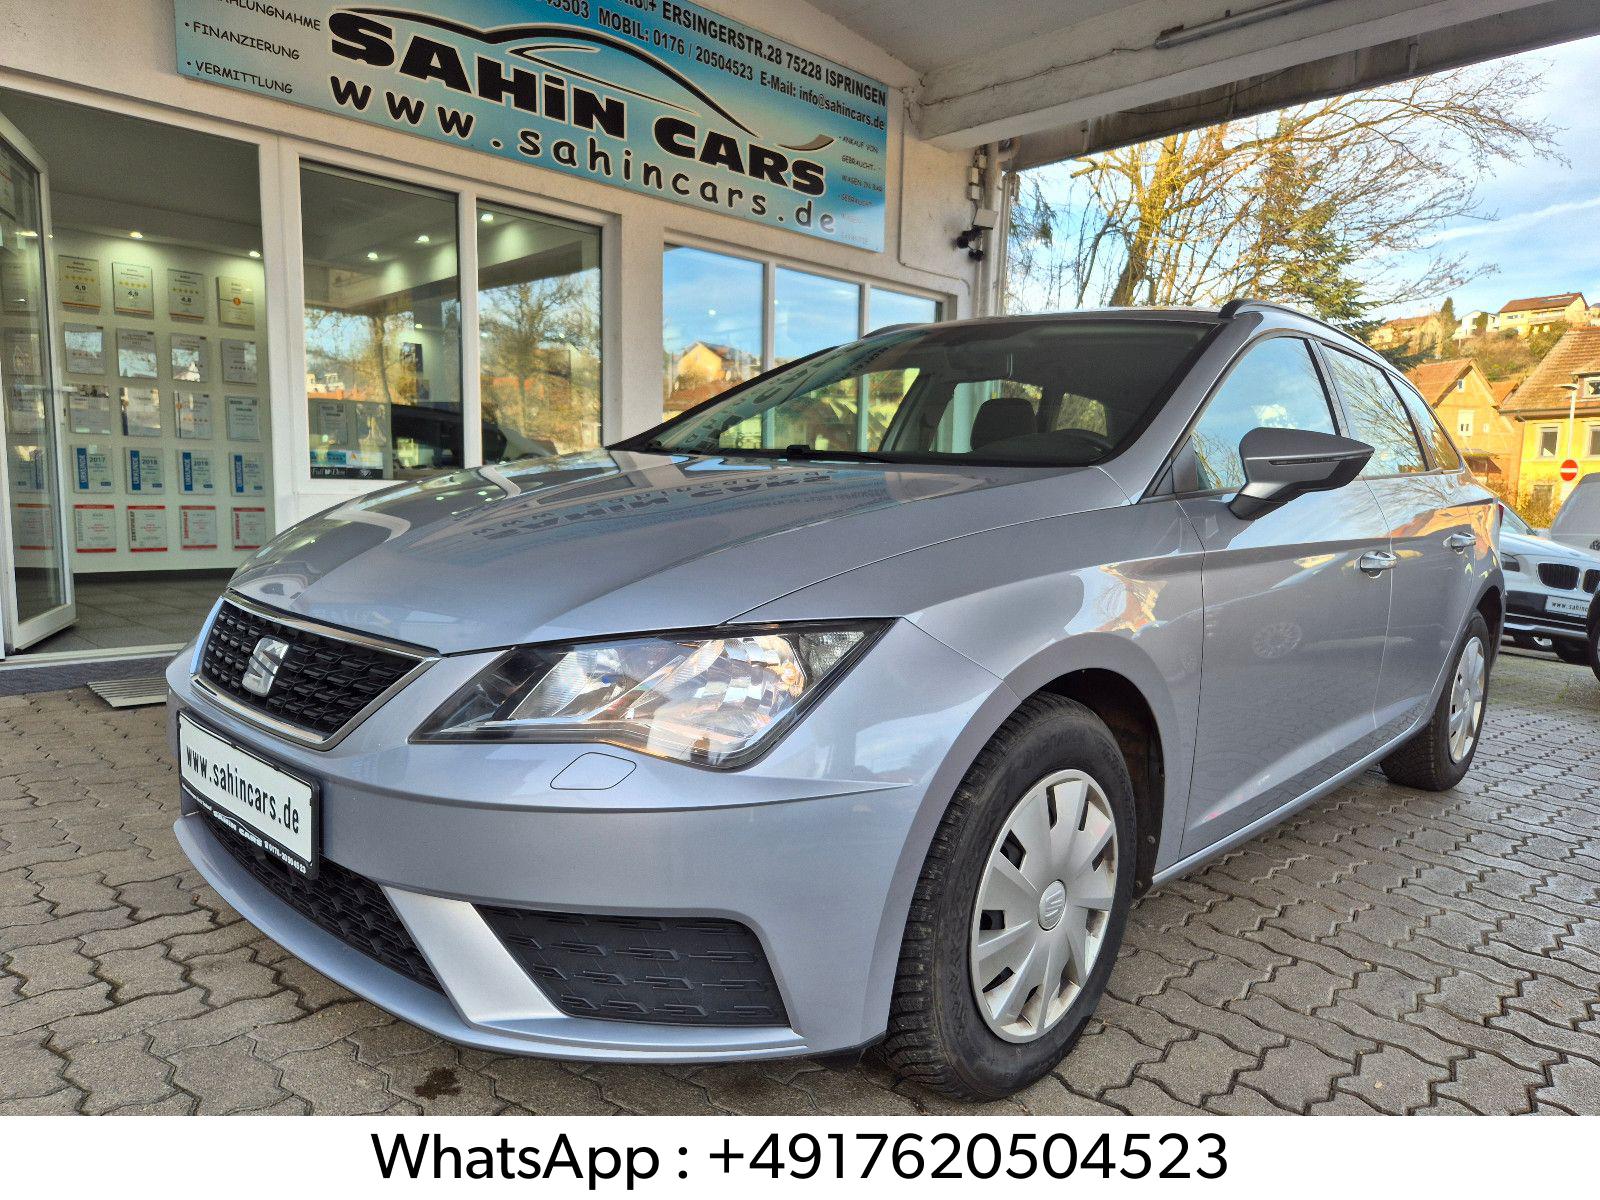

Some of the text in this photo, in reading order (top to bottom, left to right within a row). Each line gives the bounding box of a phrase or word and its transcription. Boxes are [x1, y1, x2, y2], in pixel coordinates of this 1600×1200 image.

[193, 21, 300, 60] FINANZIERUNG
[217, 0, 321, 31] HLUNGNAHME
[662, 1, 886, 107] ERSINGERSTR.28 75228 ISPRINGEN
[195, 59, 293, 94] VERMITTLUNG
[599, 7, 648, 42] MOBIL:
[653, 29, 685, 55] 0176
[695, 45, 753, 81] 20504523
[760, 71, 796, 98] E-Mail:
[799, 85, 885, 131] info@sahincars.de
[654, 116, 825, 196] CARS
[186, 745, 300, 834] www.sahincars.de
